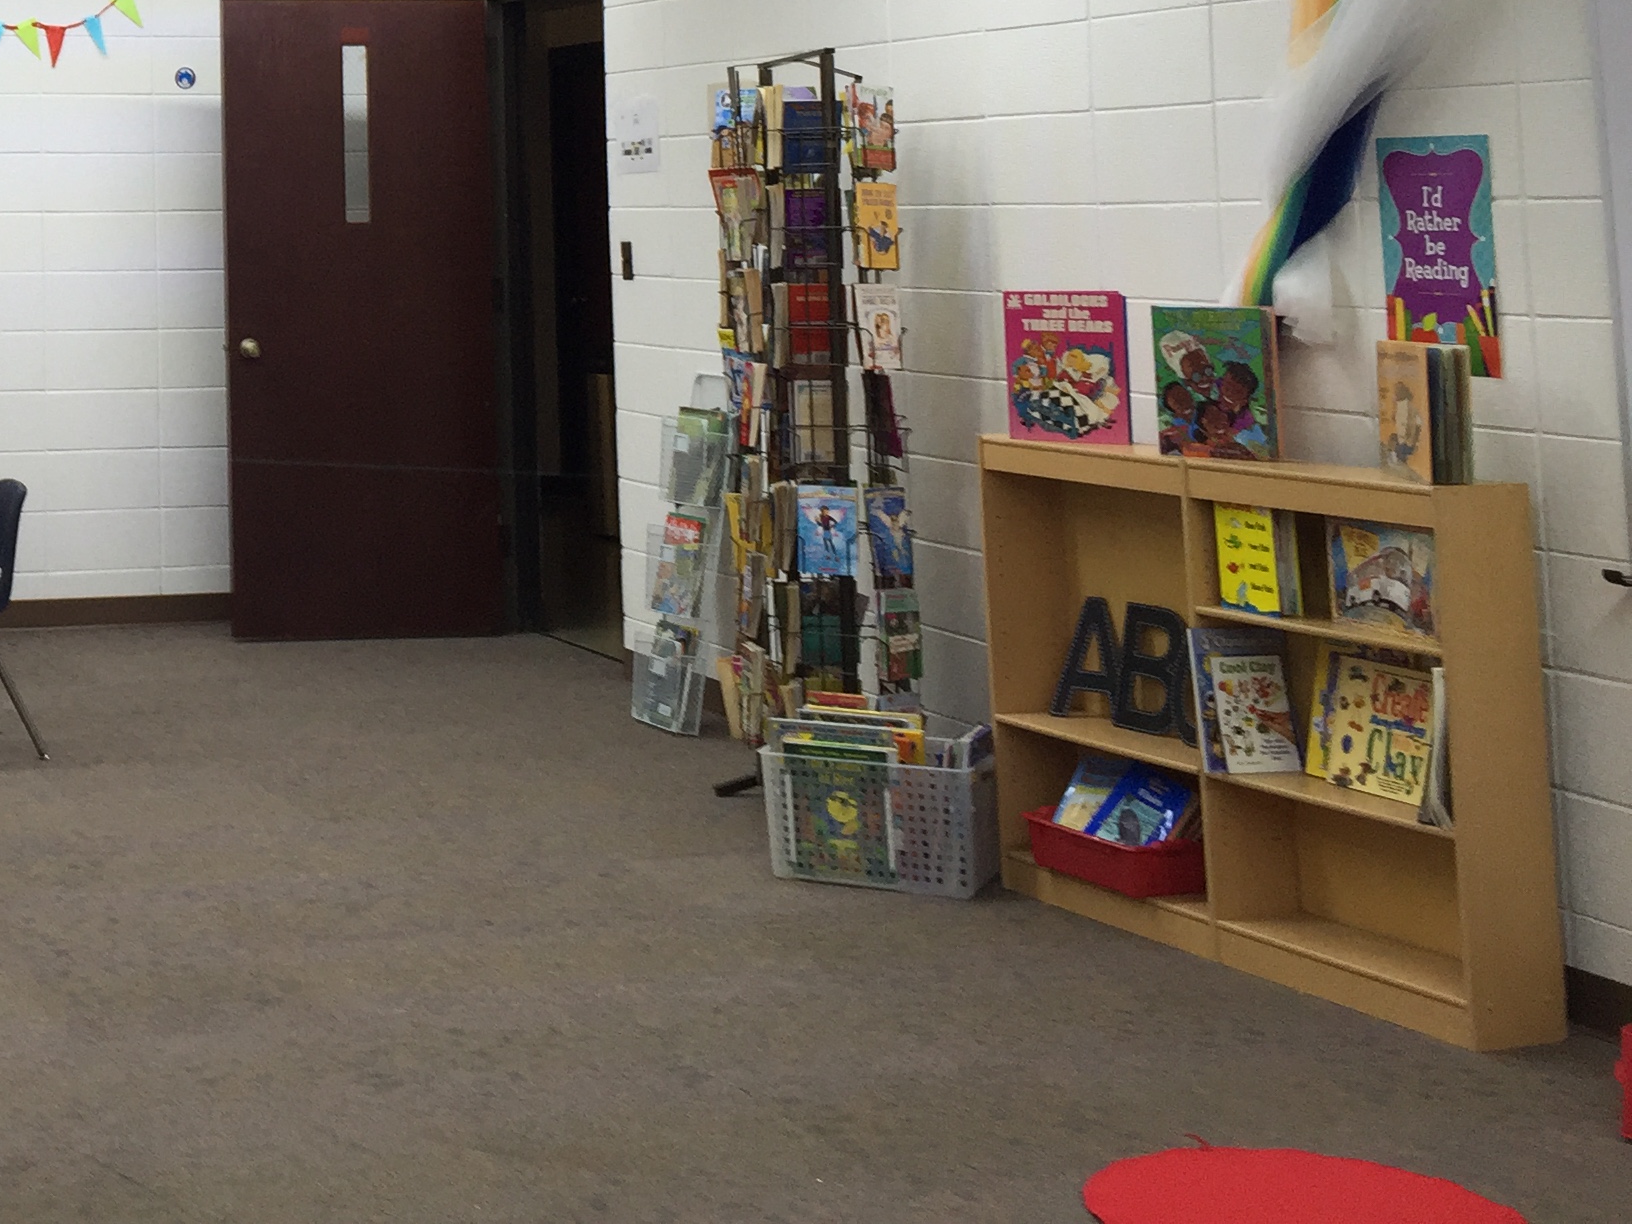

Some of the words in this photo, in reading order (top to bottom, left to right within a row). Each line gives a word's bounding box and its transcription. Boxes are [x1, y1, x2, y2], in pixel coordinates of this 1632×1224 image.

[1421, 185, 1443, 208] I'd
[1405, 210, 1462, 234] Rather
[1424, 234, 1446, 255] be
[1404, 257, 1469, 288] Reading
